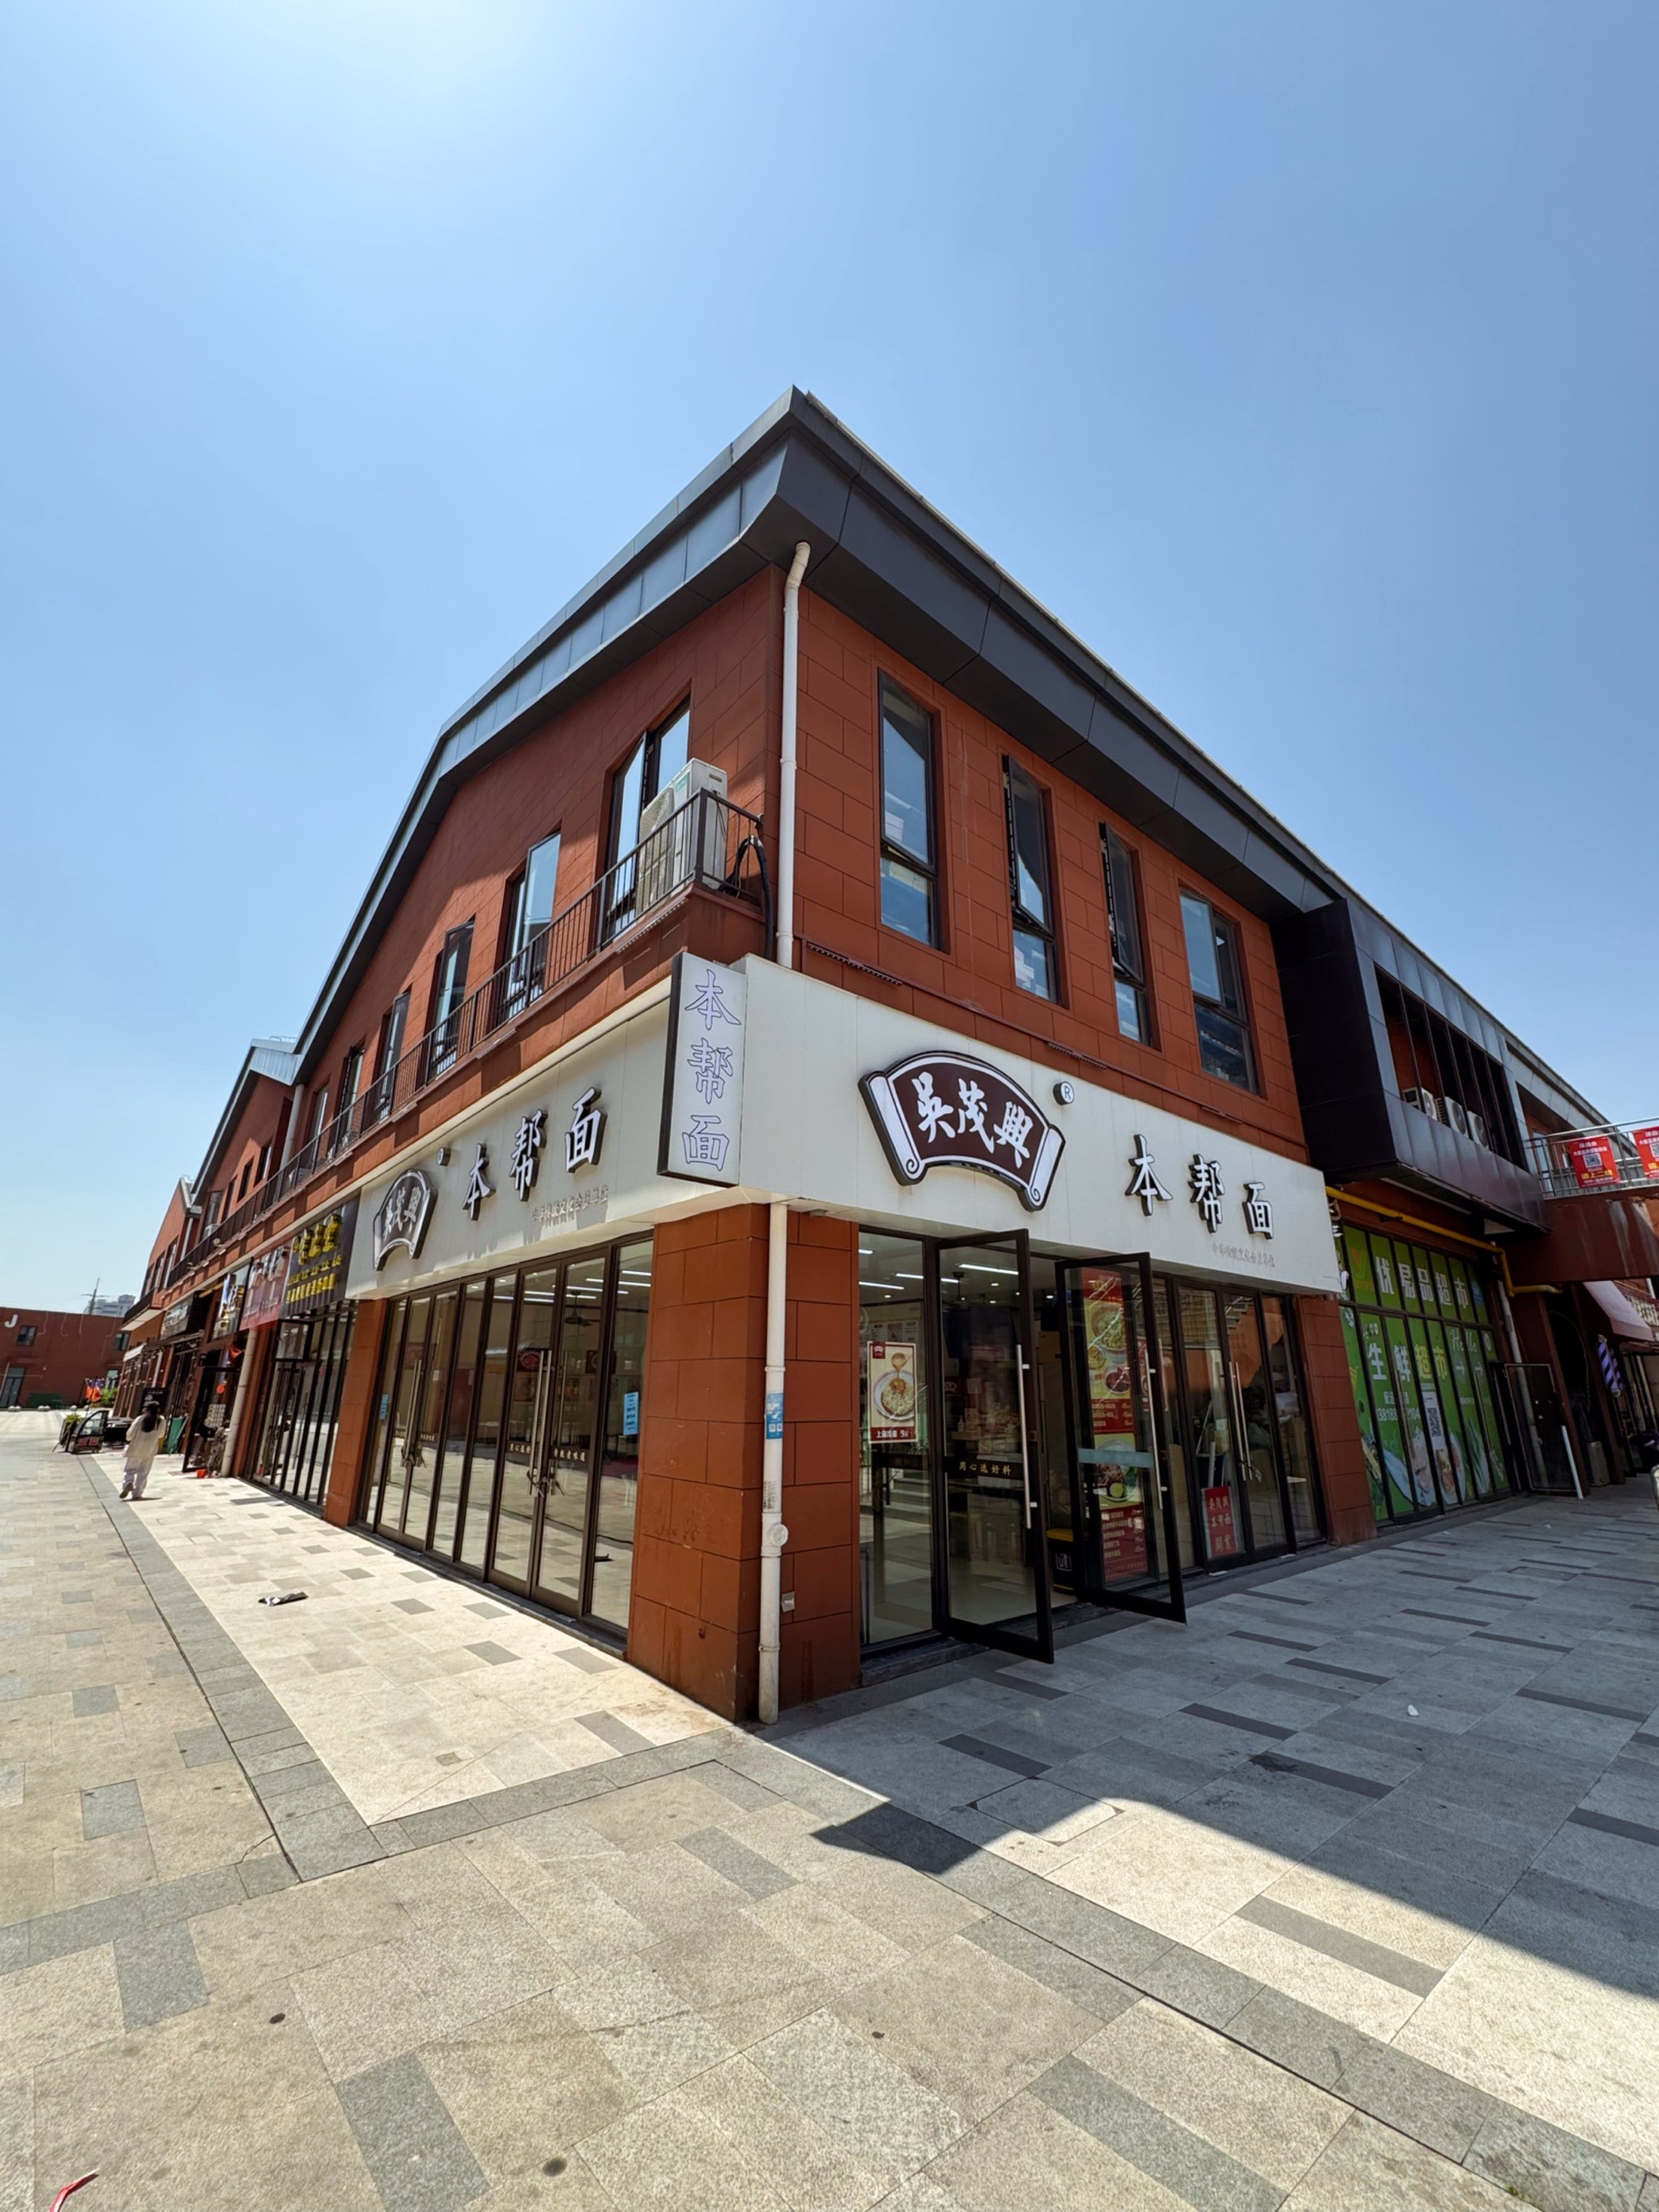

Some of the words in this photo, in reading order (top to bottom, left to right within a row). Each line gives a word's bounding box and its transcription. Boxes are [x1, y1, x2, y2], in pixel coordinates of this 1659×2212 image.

[681, 969, 742, 1172] 本帮面
[463, 1087, 608, 1221] 本帮面
[1124, 1134, 1275, 1240] 本帮面
[4, 1313, 19, 1328] J
[1375, 1256, 1470, 1309] 优易品超市
[1367, 1342, 1448, 1382] 生鲜超市
